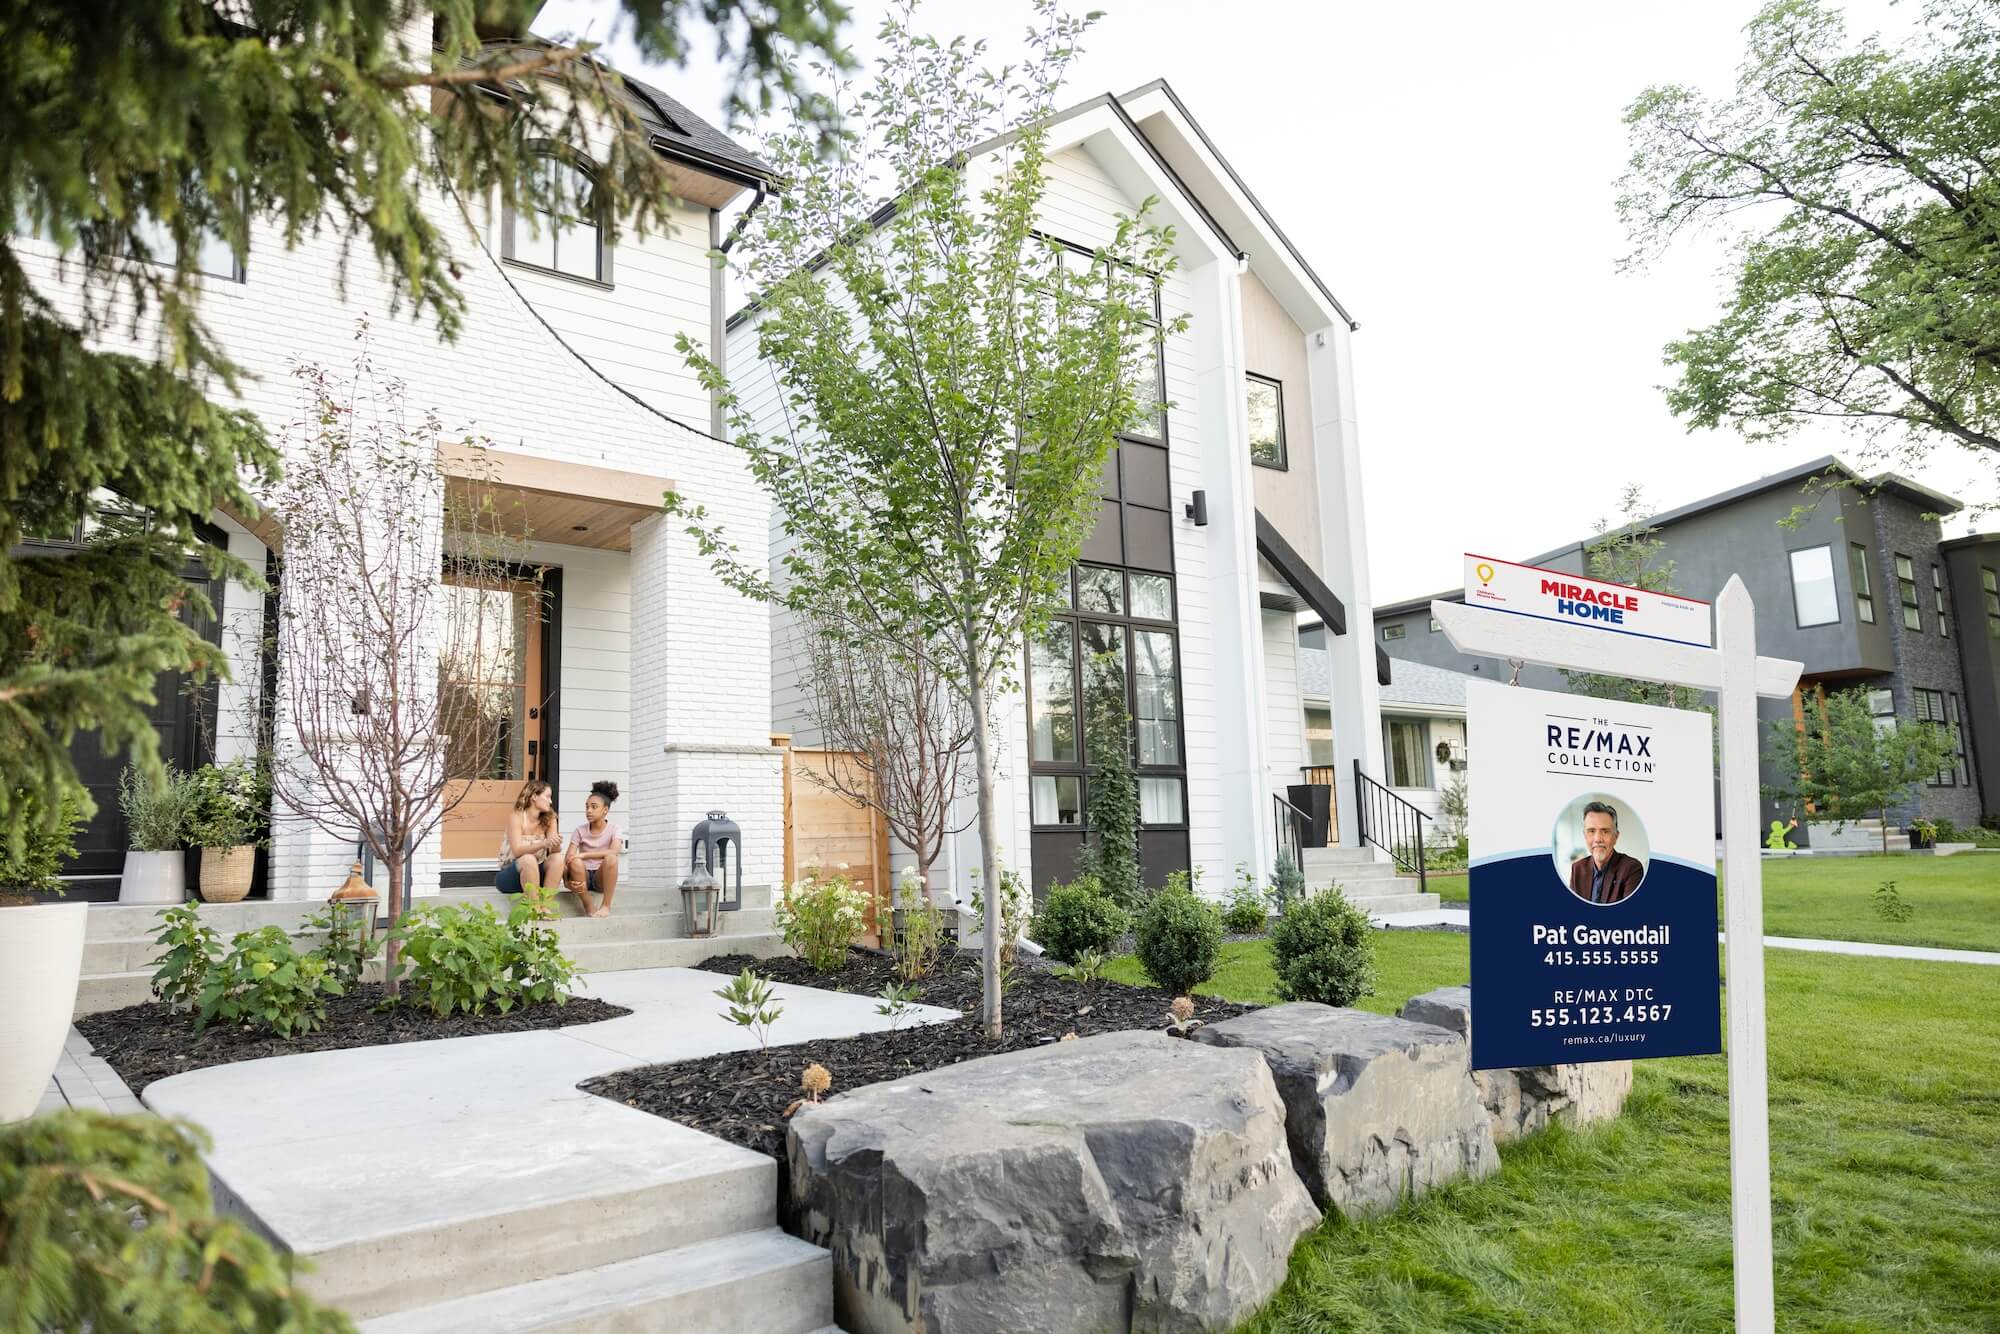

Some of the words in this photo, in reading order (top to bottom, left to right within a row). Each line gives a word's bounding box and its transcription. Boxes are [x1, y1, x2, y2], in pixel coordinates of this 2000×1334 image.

[1541, 579, 1638, 611] MIRACLE
[1558, 599, 1623, 624] HOME
[1593, 718, 1608, 726] THE
[1547, 725, 1651, 757] RE/MAX
[1548, 752, 1653, 773] COLLECTION
[1533, 925, 1567, 945] Pat
[1573, 925, 1670, 945] Gavendail
[1544, 951, 1659, 965] 415.555.5555
[1554, 989, 1618, 1004] RE/MAX
[1625, 988, 1654, 1001] DTC
[1531, 1004, 1672, 1027] 555.123.4567
[1563, 1033, 1646, 1045] remax.ca/luxury
